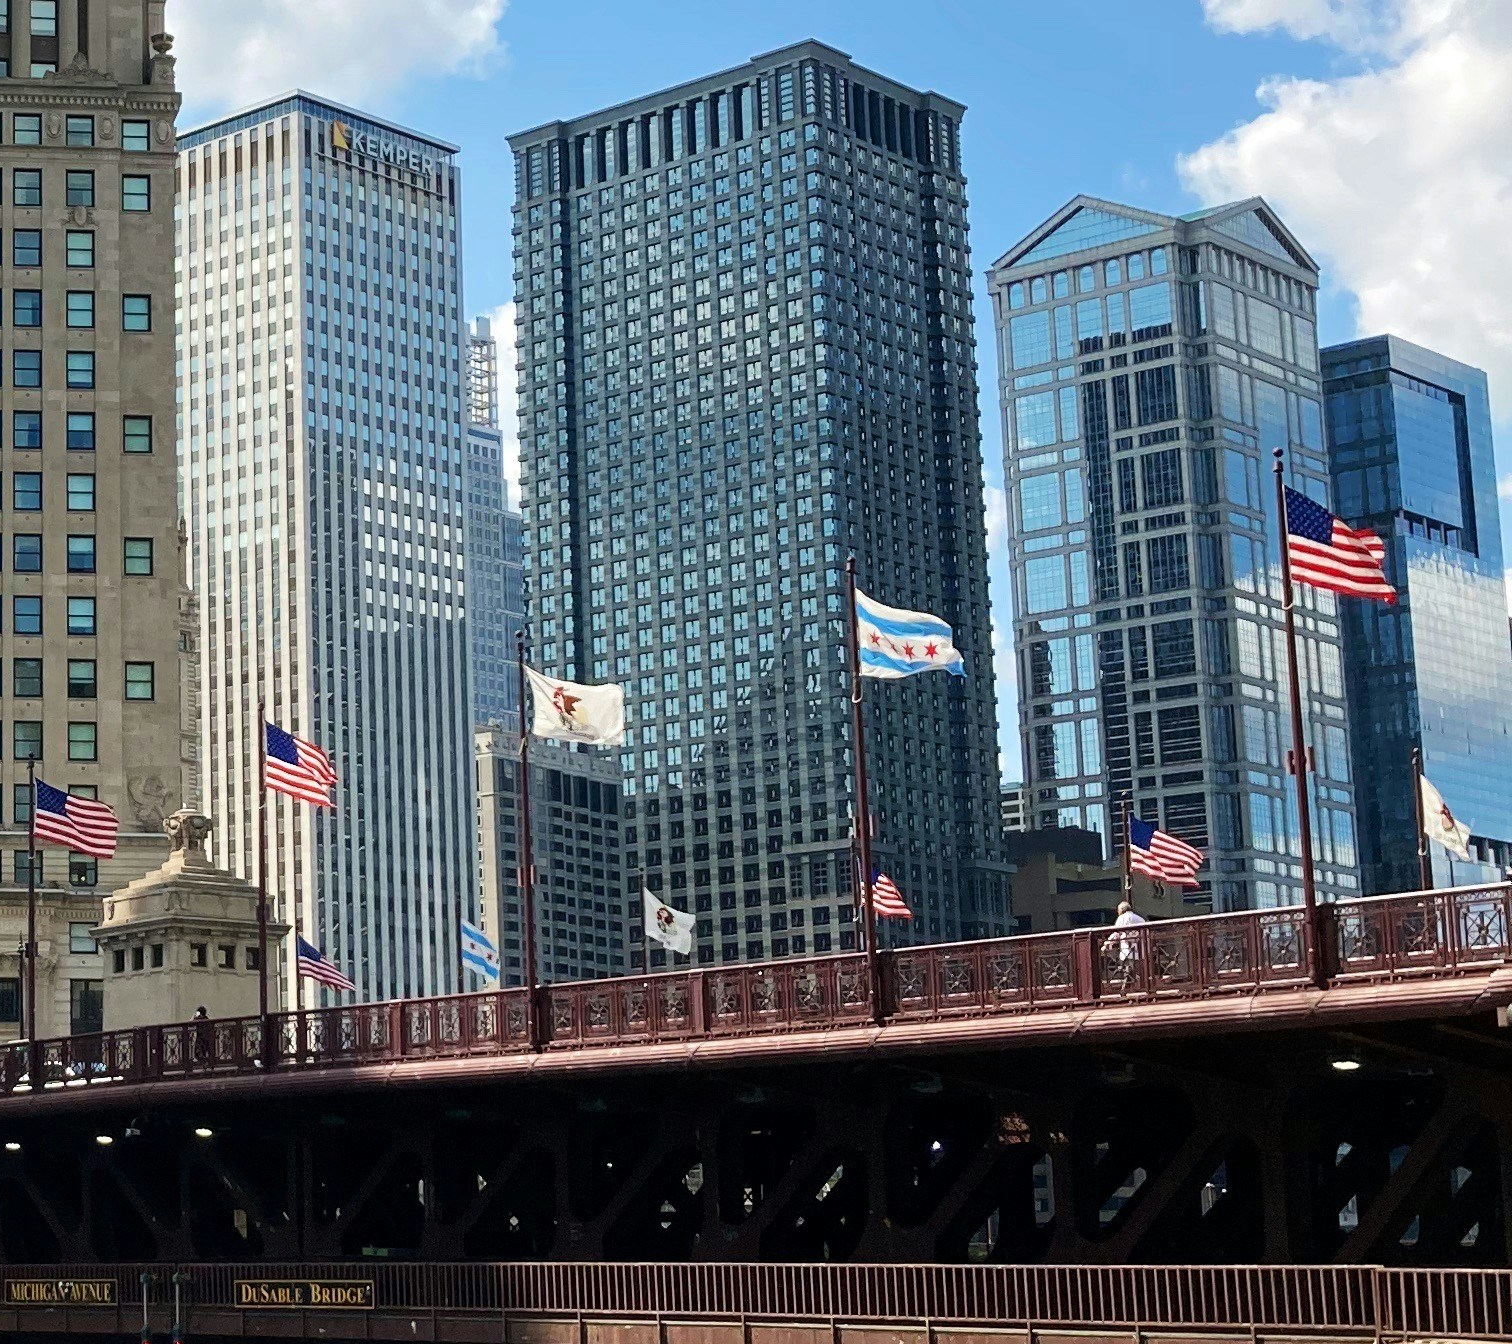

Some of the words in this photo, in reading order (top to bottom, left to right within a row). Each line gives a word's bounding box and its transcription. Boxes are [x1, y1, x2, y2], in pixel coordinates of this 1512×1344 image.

[352, 129, 433, 175] KEMPER
[11, 1282, 66, 1301] MICHIGAN
[70, 1282, 111, 1302] AVENUE
